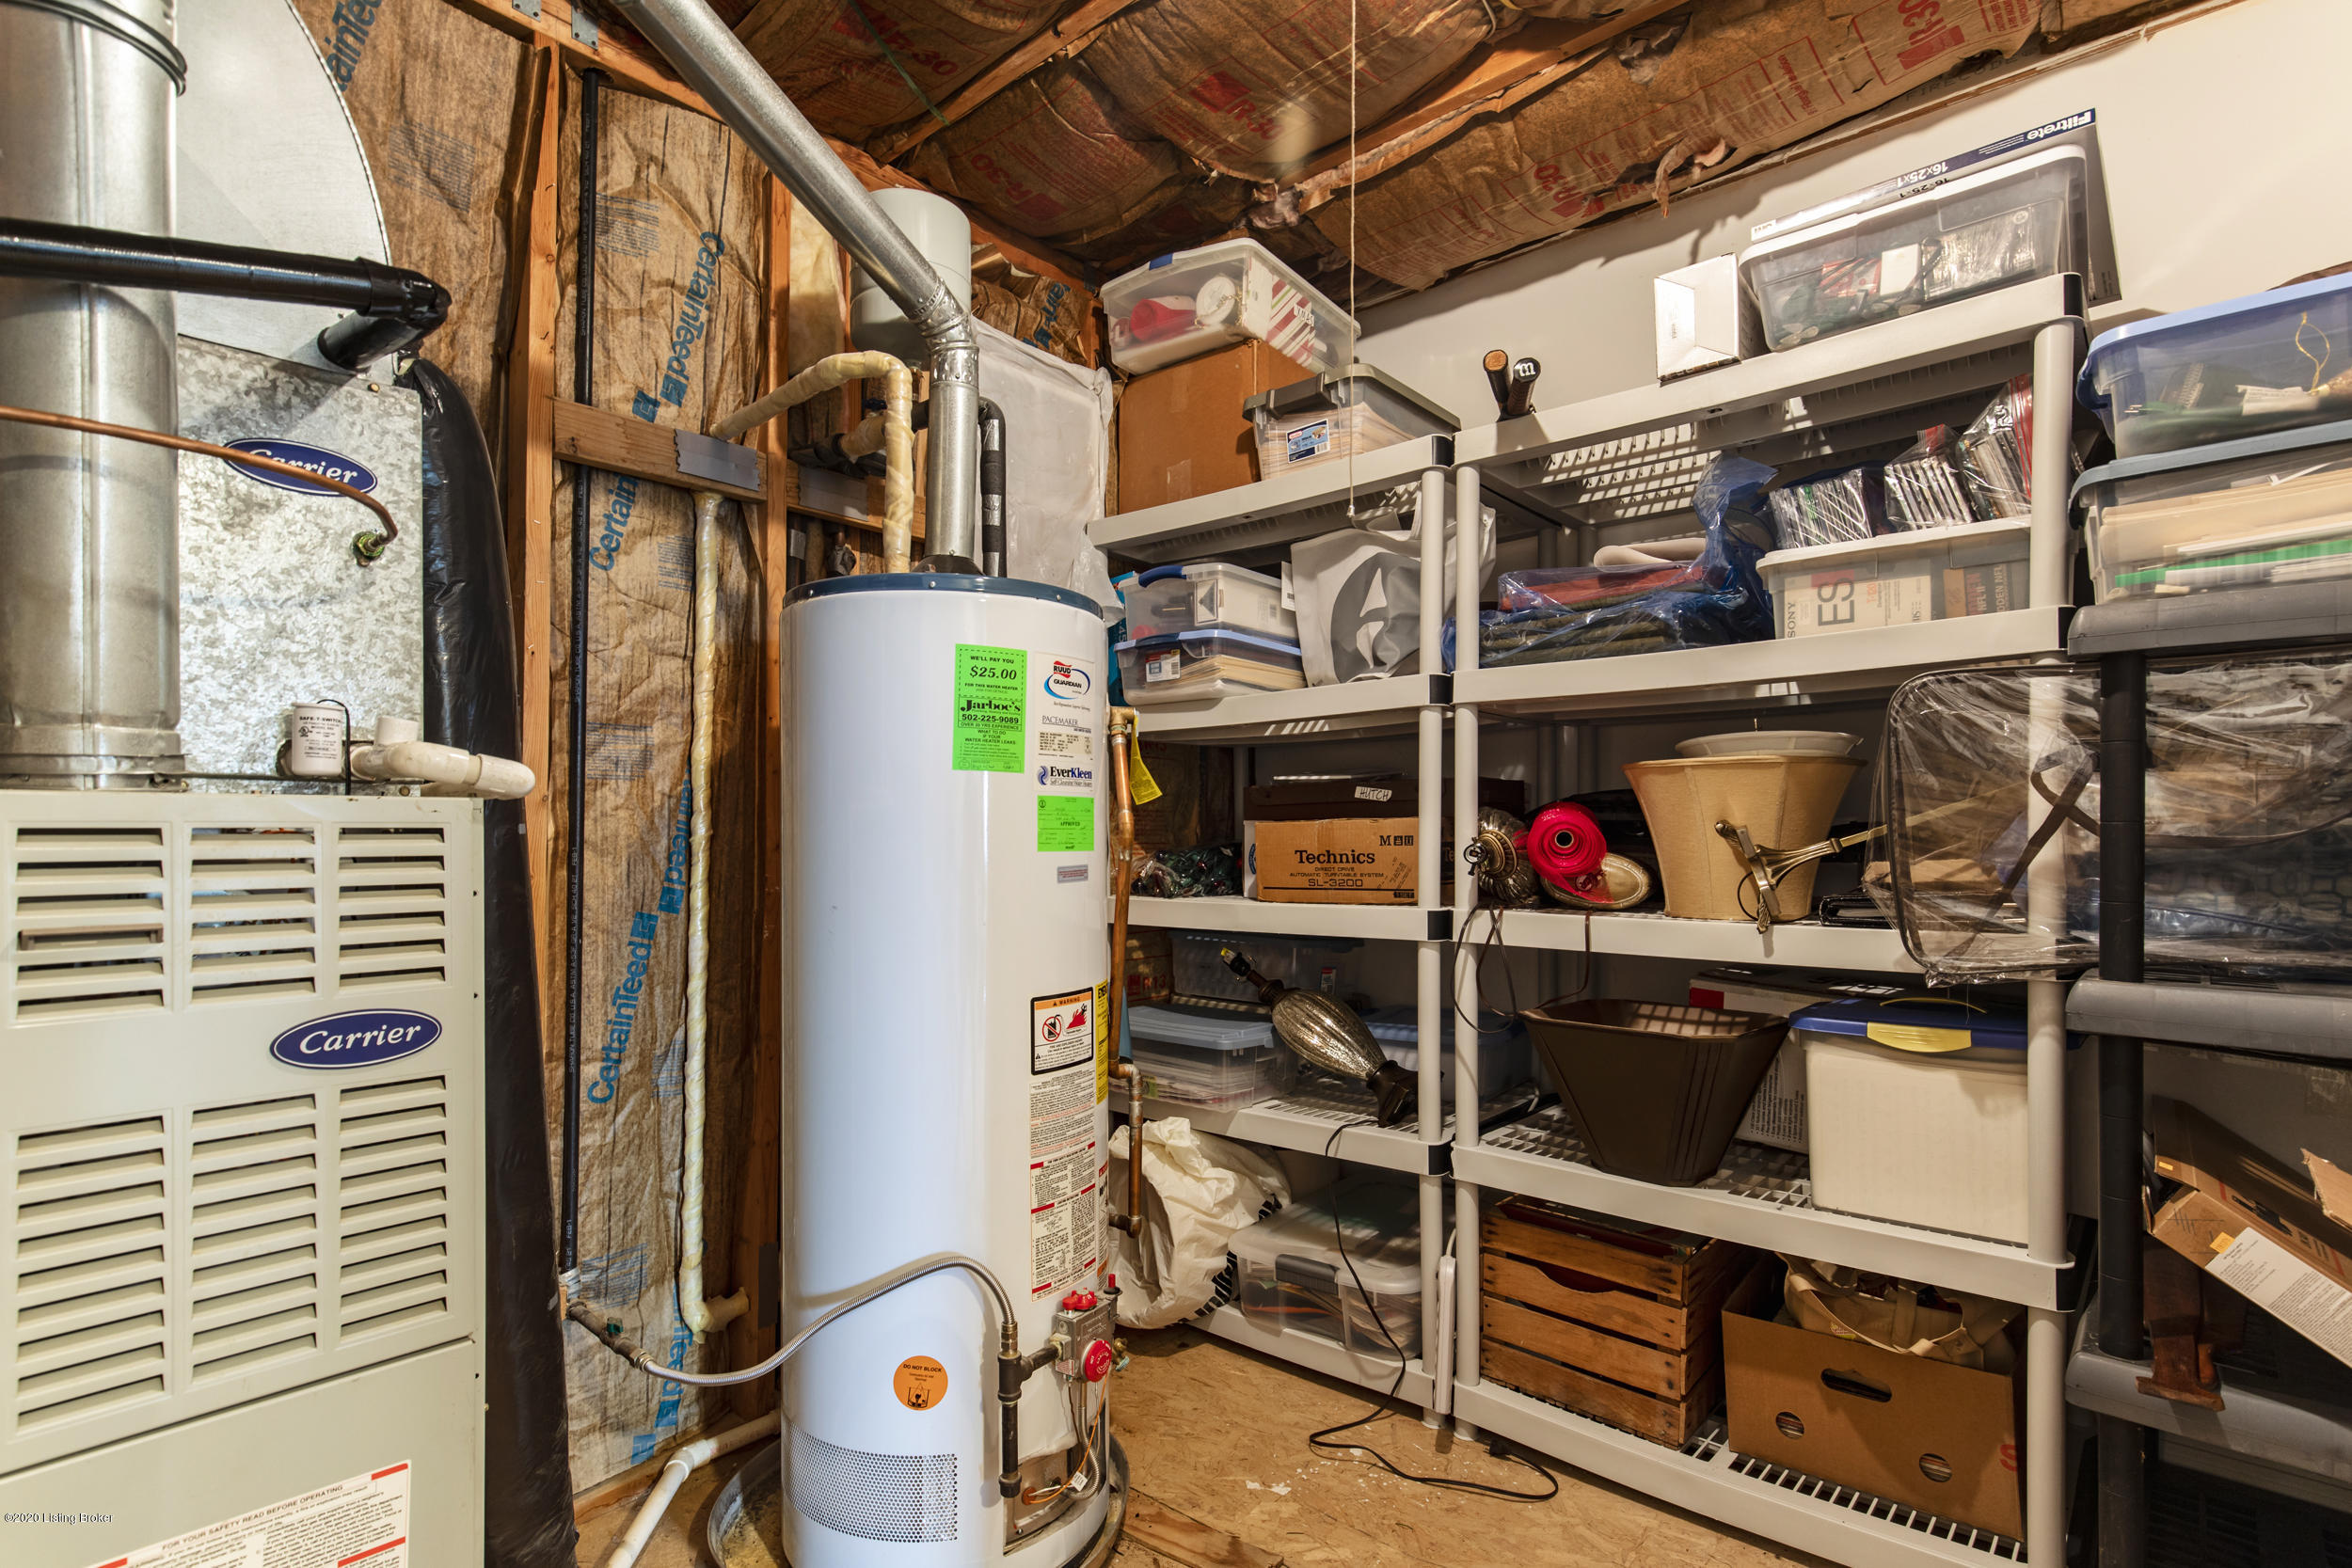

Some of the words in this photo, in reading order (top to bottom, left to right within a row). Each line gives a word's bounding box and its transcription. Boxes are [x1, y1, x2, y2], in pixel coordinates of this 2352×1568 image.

[2026, 111, 2092, 140] Filtrete
[1896, 161, 1948, 188] 16x25x1
[666, 231, 725, 381] CertainTeed
[1818, 577, 1855, 626] ES
[1788, 602, 1797, 639] SONY
[969, 664, 1017, 680] $25.00
[1053, 665, 1072, 674] RUUD
[1053, 678, 1082, 689] GUARDIAN
[960, 699, 1021, 712] Jarboe's
[961, 713, 1019, 724] 502-225-9089
[1041, 715, 1078, 726] PACEMAKER
[1049, 766, 1092, 780] EverKleen
[1359, 786, 1390, 800] HUTCH
[1294, 849, 1375, 864] Technics
[1308, 879, 1363, 888] SL-3200
[587, 940, 652, 1104] CertainTeed
[299, 1024, 421, 1054] Carrier
[162, 1540, 180, 1551] FOR
[183, 1531, 206, 1544] YOUR
[208, 1520, 241, 1535] SAFETY
[242, 1513, 264, 1524] READ
[266, 1500, 298, 1516] BEFORE
[299, 1484, 343, 1504] OPERATING
